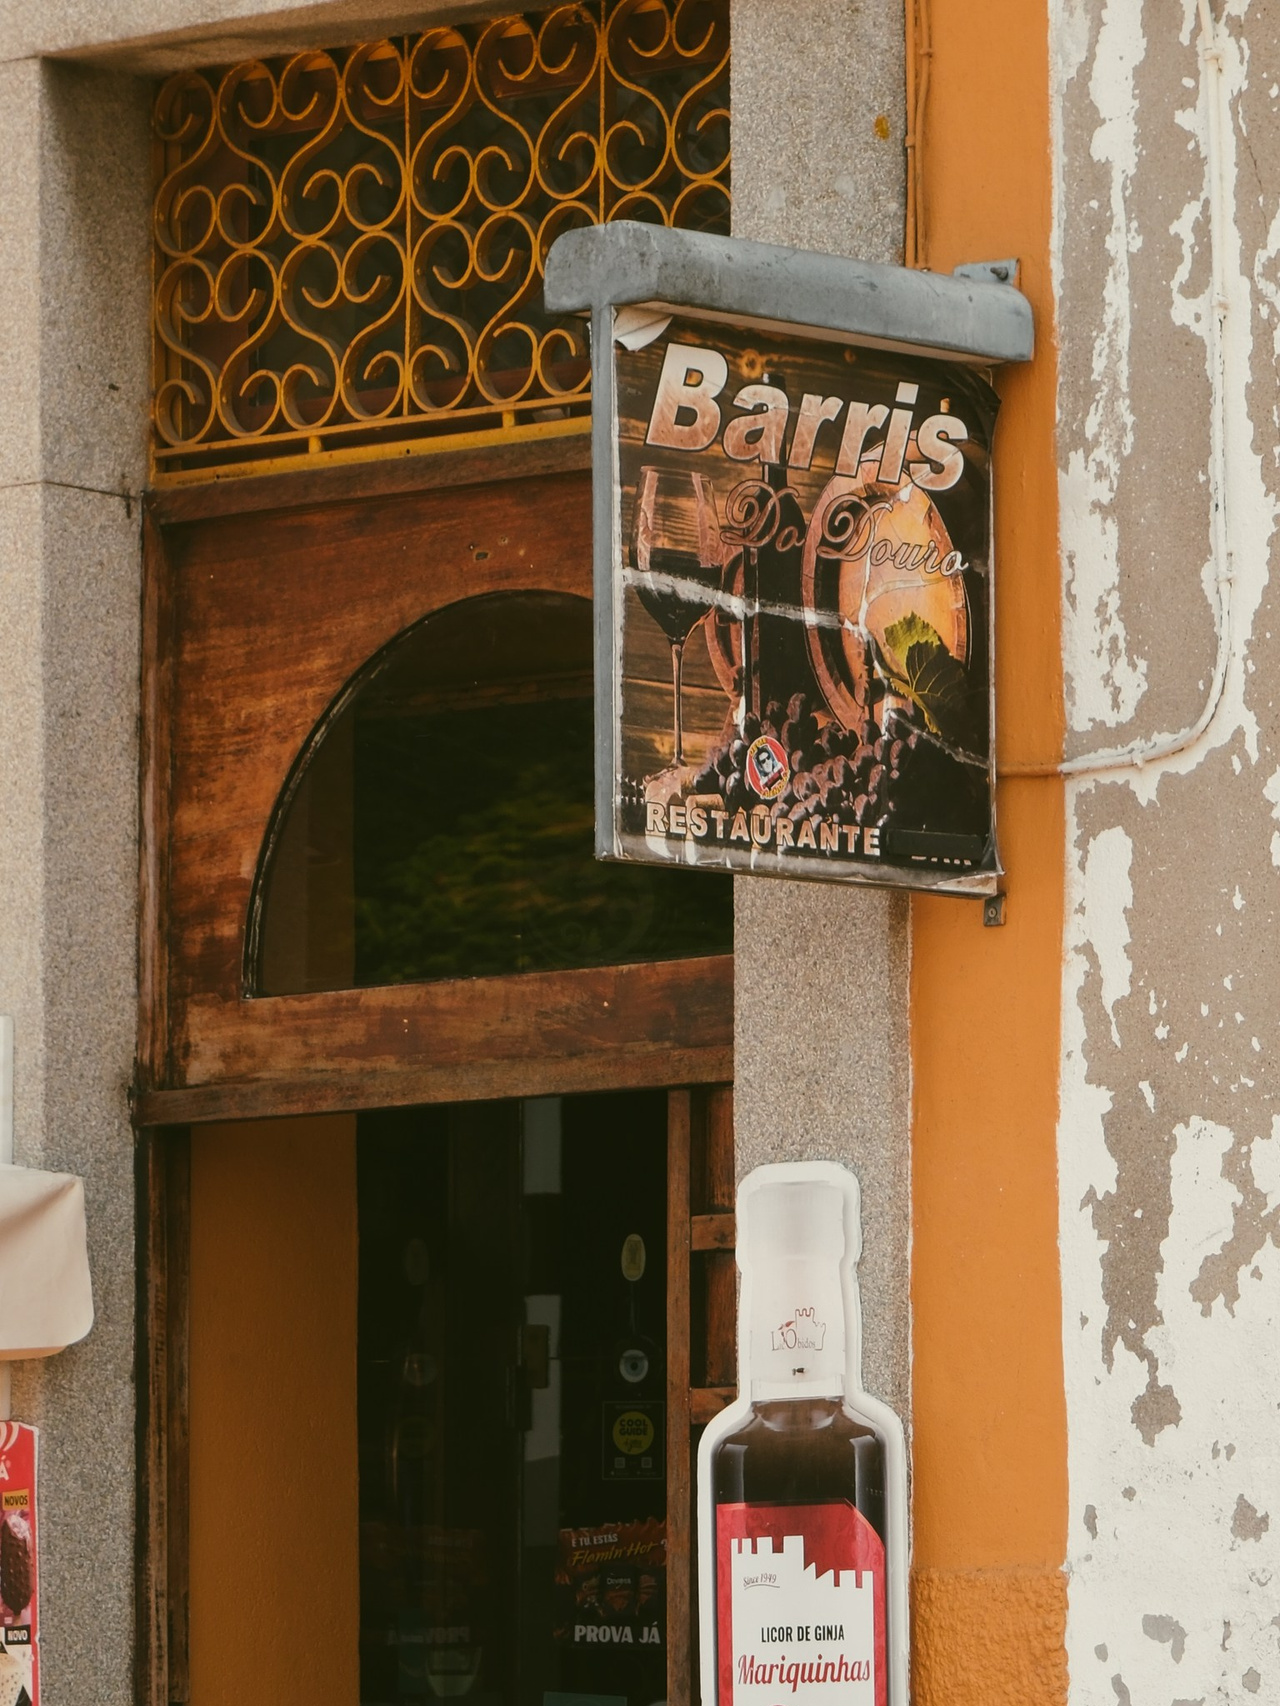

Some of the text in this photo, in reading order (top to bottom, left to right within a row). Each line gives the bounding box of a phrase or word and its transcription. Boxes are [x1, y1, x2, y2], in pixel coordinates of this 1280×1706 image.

[646, 342, 968, 491] Barris
[720, 479, 968, 577] Do Douro
[646, 802, 881, 857] RESTAURANTE
[619, 1428, 648, 1436] GUIDE
[620, 1419, 648, 1427] COOL
[4, 1495, 28, 1506] NOVOS
[593, 1533, 618, 1545] ESTÁS
[8, 1629, 28, 1641] NOVO
[574, 1621, 660, 1644] PROVA JÁ
[761, 1624, 845, 1643] LICOR DE GINJA
[738, 1653, 871, 1693] Mariquinhas
